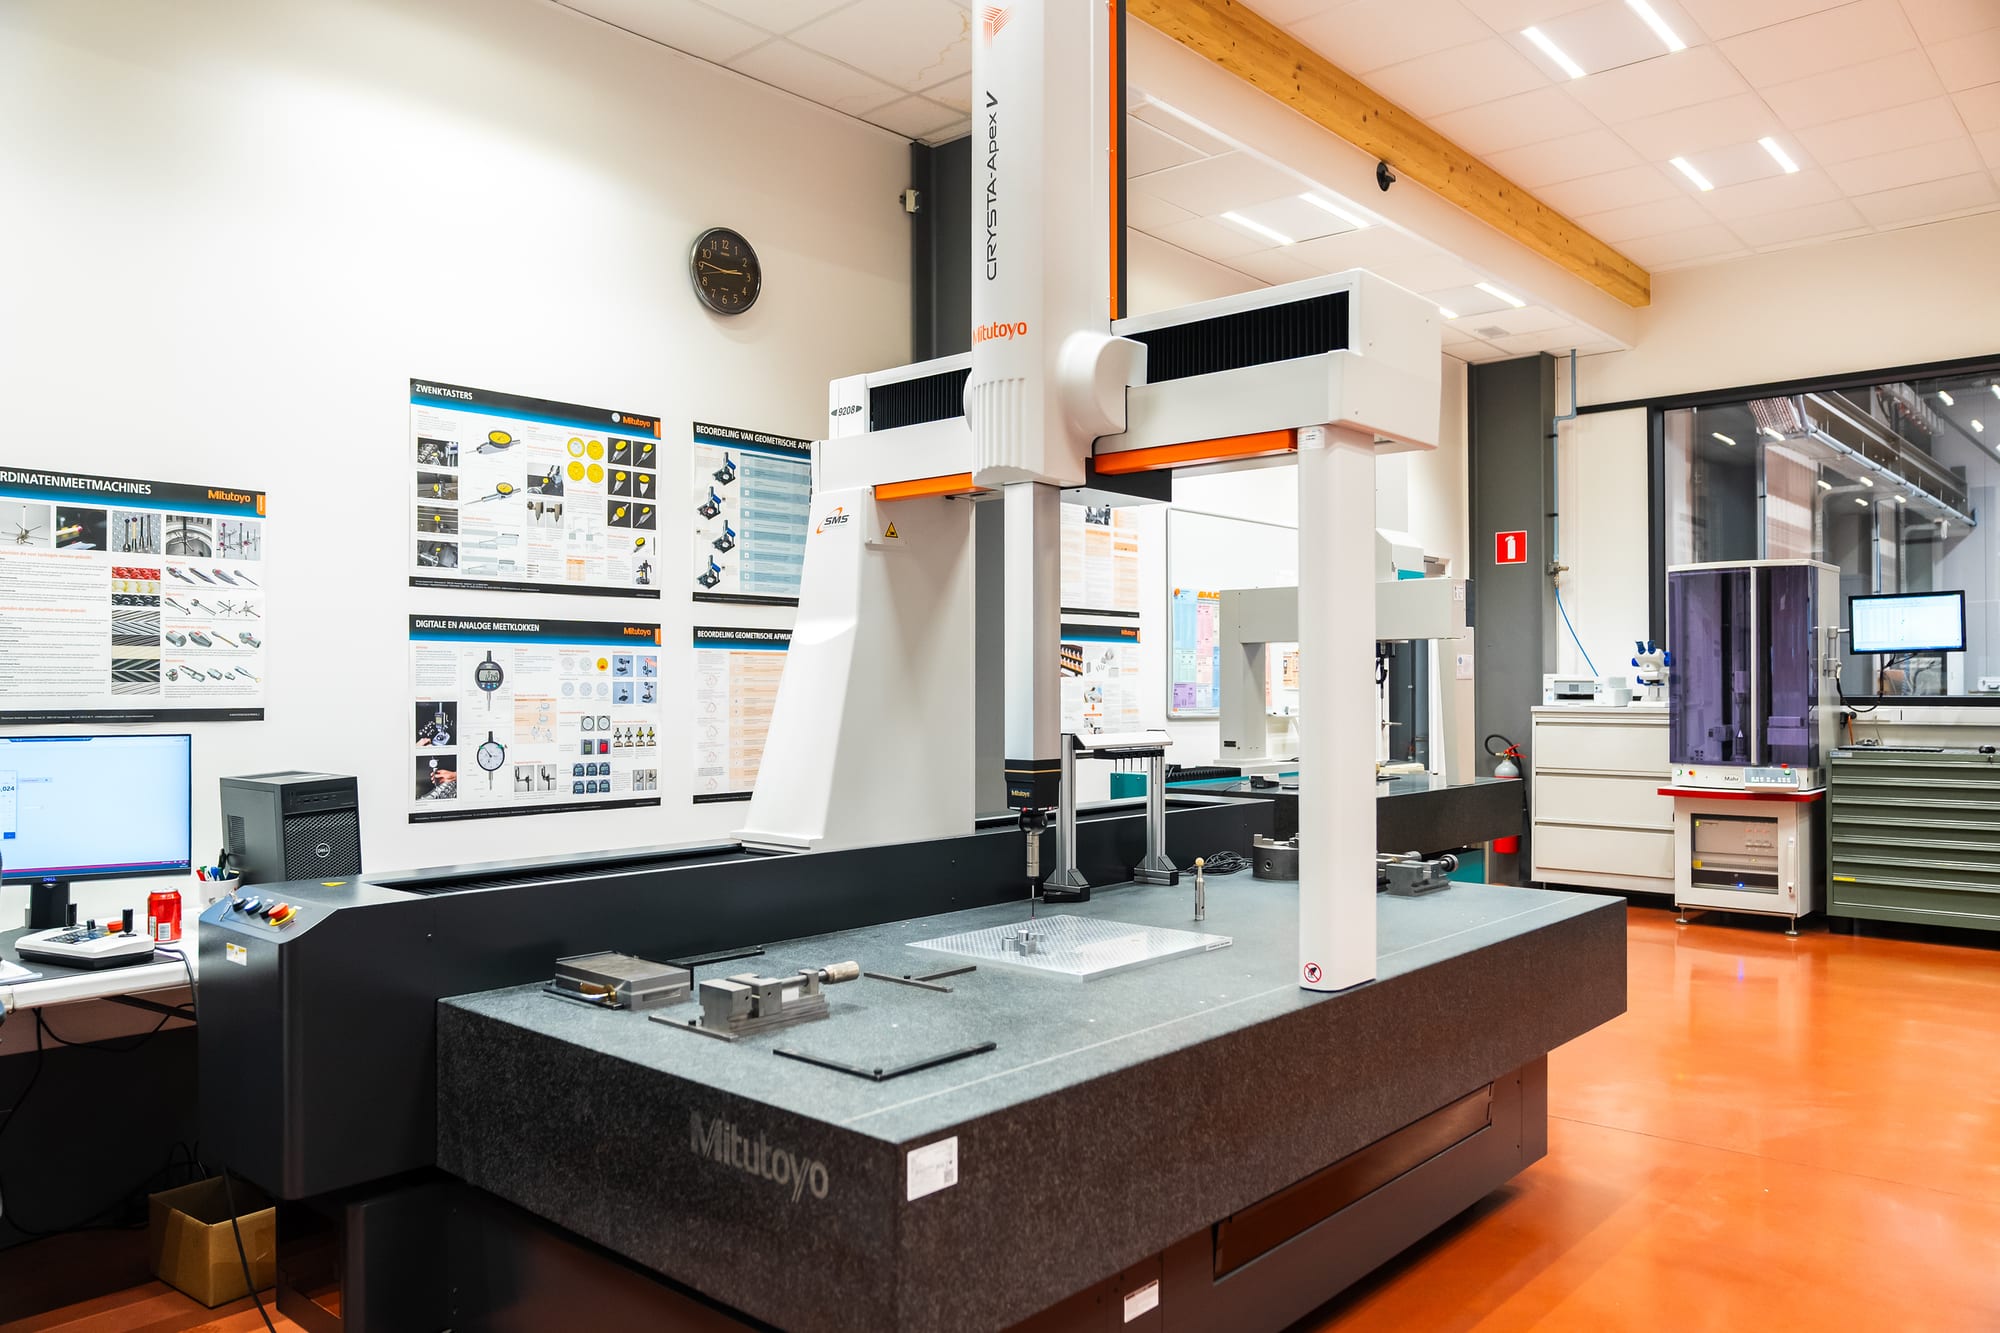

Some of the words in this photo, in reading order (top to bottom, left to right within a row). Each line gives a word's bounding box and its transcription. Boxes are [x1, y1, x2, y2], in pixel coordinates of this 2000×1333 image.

[986, 90, 999, 108] V
[986, 112, 999, 281] CRYSTA-Apex
[711, 240, 718, 251] 11
[722, 240, 729, 250] 12
[702, 248, 712, 260] 10
[734, 246, 738, 256] 1
[698, 261, 704, 271] 9
[743, 257, 747, 267] 2
[702, 276, 708, 286] 8
[746, 273, 751, 282] 3
[711, 288, 716, 298] 7
[742, 287, 747, 296] 4
[722, 295, 728, 304] 6
[733, 294, 738, 303] 5
[973, 321, 1027, 346] Mitutoyo
[416, 383, 473, 401] ZWENKTASTERS
[838, 405, 856, 417] 9208
[622, 415, 651, 428] Mitutoyo
[696, 425, 740, 439] BEOORDELING
[741, 431, 754, 441] VAN
[754, 435, 797, 449] GEOMETRISCHE
[0, 470, 152, 495] RDINATENMEETMACHINES
[208, 489, 251, 503] Mitutoyo
[824, 514, 850, 526] SMS
[415, 619, 446, 629] DIGITALE
[447, 620, 457, 629] EN
[458, 621, 492, 630] ANALOGE
[492, 622, 540, 632] MEETKLOKKEN
[623, 626, 652, 637] Mitutoyo
[697, 630, 734, 639] BEOORDELING
[735, 631, 773, 640] GEOMETRISCHE
[0, 785, 15, 793] ,024
[690, 1110, 829, 1203] Mitutoyo
